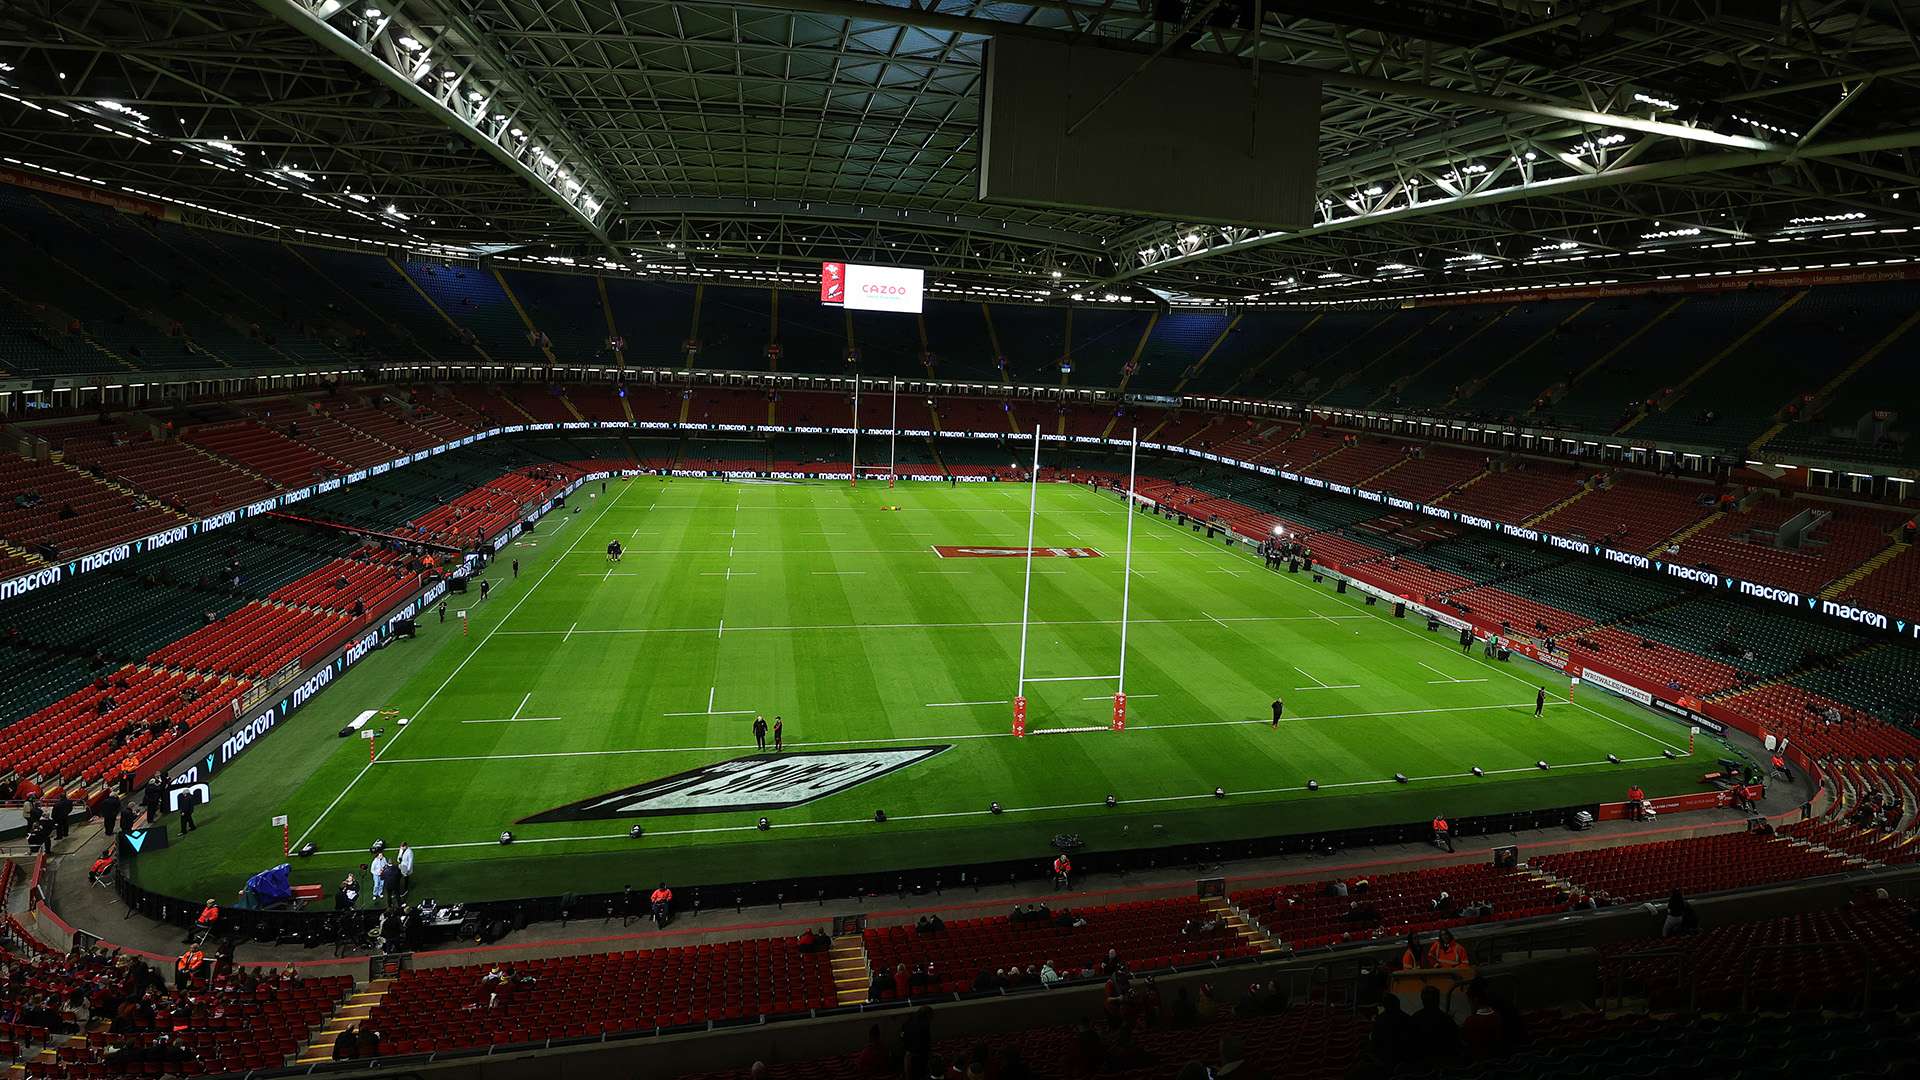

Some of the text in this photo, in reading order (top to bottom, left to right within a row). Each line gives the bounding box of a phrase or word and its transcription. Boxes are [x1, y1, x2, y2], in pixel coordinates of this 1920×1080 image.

[862, 284, 906, 295] CAZOO
[530, 422, 553, 430] macron
[563, 421, 589, 429] macron
[601, 421, 629, 429] macron
[640, 421, 669, 429] macron
[679, 422, 707, 430] macron
[1109, 438, 1132, 446] macron
[672, 469, 707, 477] macron
[819, 472, 851, 480] macron
[912, 474, 943, 482] macron
[1, 566, 61, 600] macron
[81, 544, 130, 574] macron
[148, 525, 188, 551] macron
[202, 510, 236, 533] macron
[247, 498, 277, 518] macron
[285, 486, 311, 505] macron
[319, 478, 341, 495] macron
[347, 469, 367, 485] macron
[1330, 482, 1350, 495] macron
[1358, 489, 1381, 503] macron
[1388, 497, 1413, 511] macron
[1422, 504, 1450, 520] macron
[1461, 513, 1491, 530] macron
[1504, 524, 1538, 542] macron
[1551, 536, 1589, 555] macron
[1605, 547, 1649, 569] macron
[1668, 562, 1718, 587] macron
[1740, 580, 1799, 607] macron
[1822, 600, 1887, 630] macron
[423, 580, 446, 606] macron
[346, 630, 378, 667] macron
[293, 664, 333, 709] macron
[221, 706, 275, 763] macron
